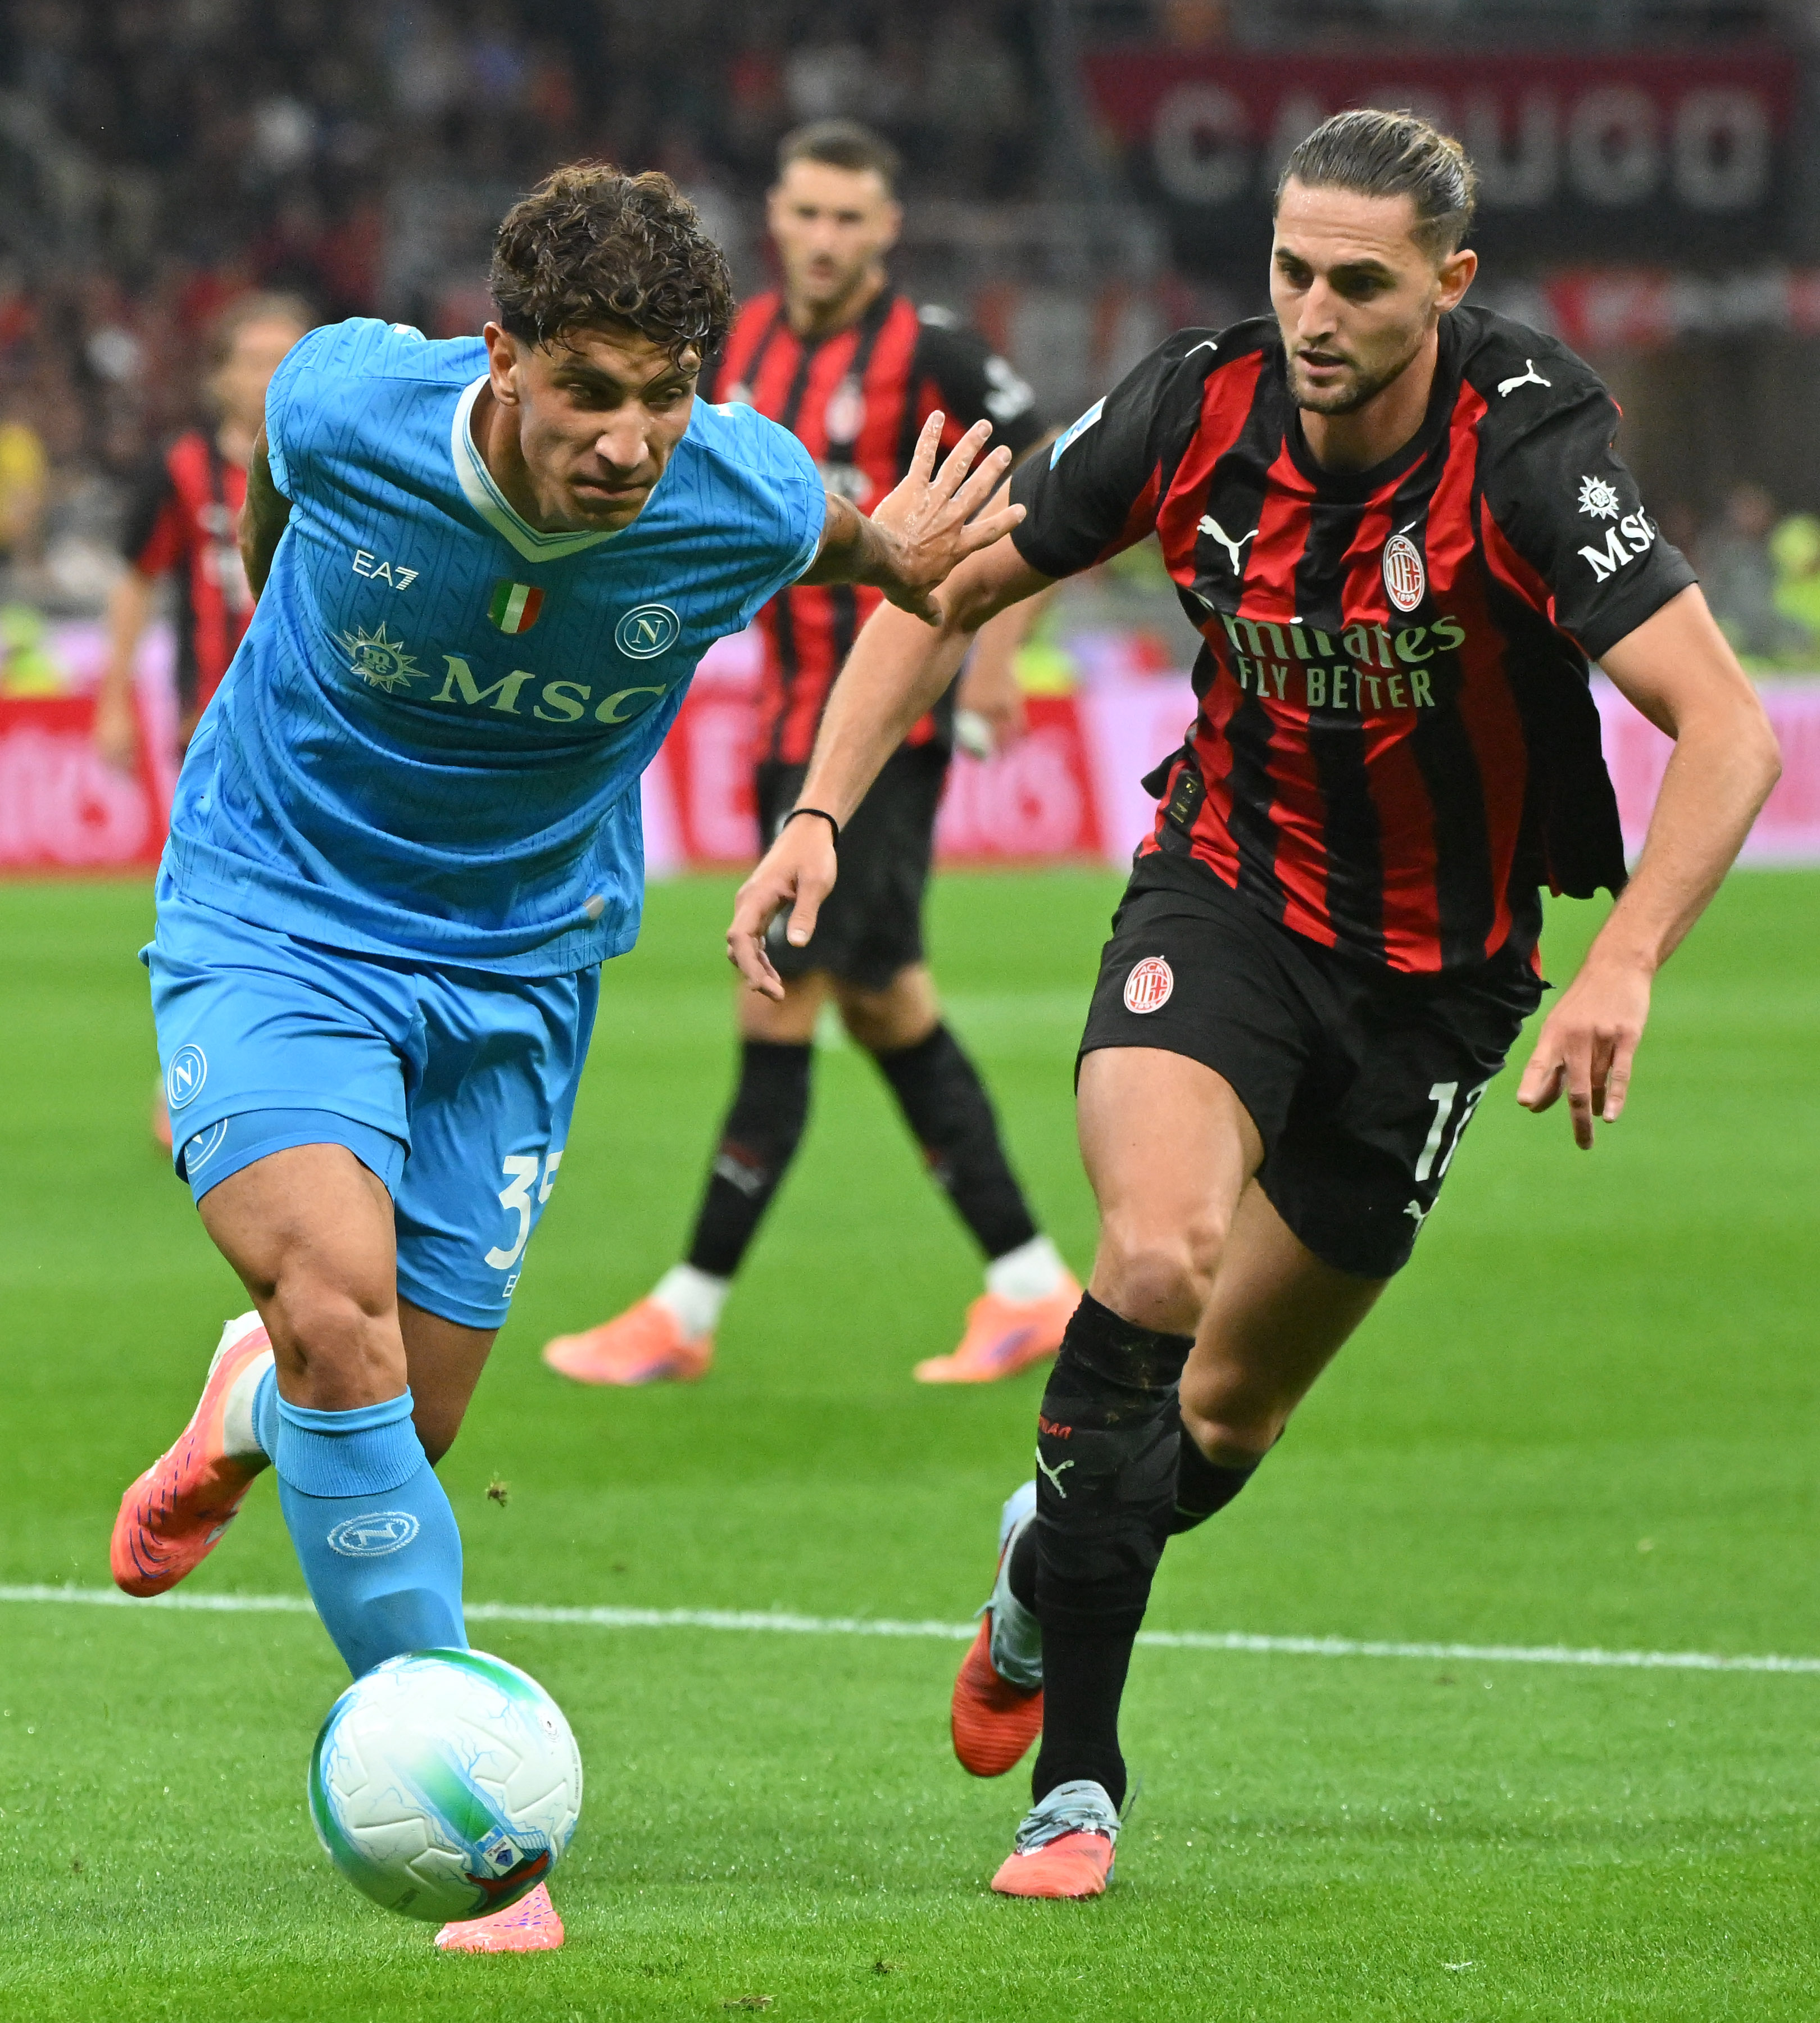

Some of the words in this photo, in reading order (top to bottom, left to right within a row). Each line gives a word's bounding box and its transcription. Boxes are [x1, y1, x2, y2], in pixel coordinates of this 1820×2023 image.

[1152, 81, 1770, 210] CAUGO
[352, 550, 419, 591] EA7
[632, 619, 664, 645] N
[1220, 615, 1466, 669] mirates
[430, 655, 667, 724] MSC
[1237, 656, 1288, 701] FLY
[1306, 665, 1436, 712] BETTER
[175, 1059, 193, 1095] N
